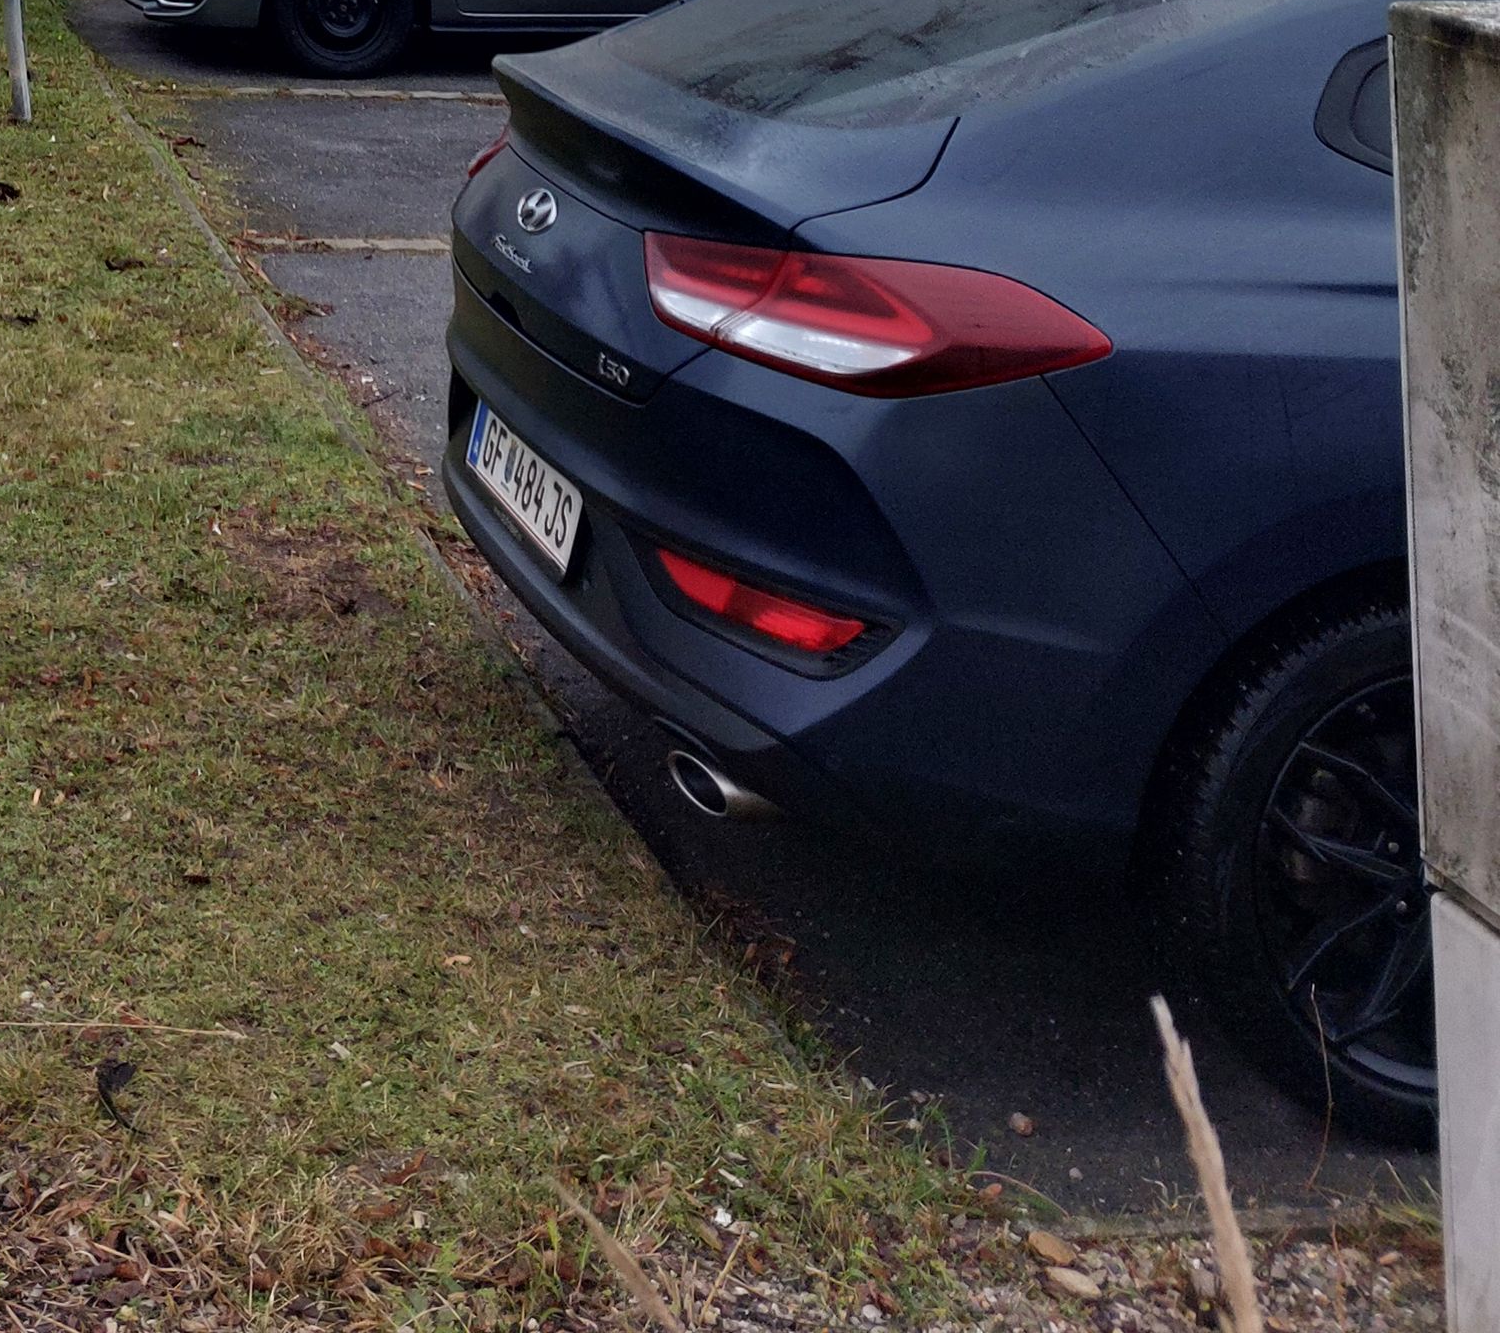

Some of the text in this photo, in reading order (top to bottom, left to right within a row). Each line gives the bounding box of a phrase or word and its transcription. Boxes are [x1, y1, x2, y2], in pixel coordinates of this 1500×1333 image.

[482, 418, 573, 549] GF 484 JS
